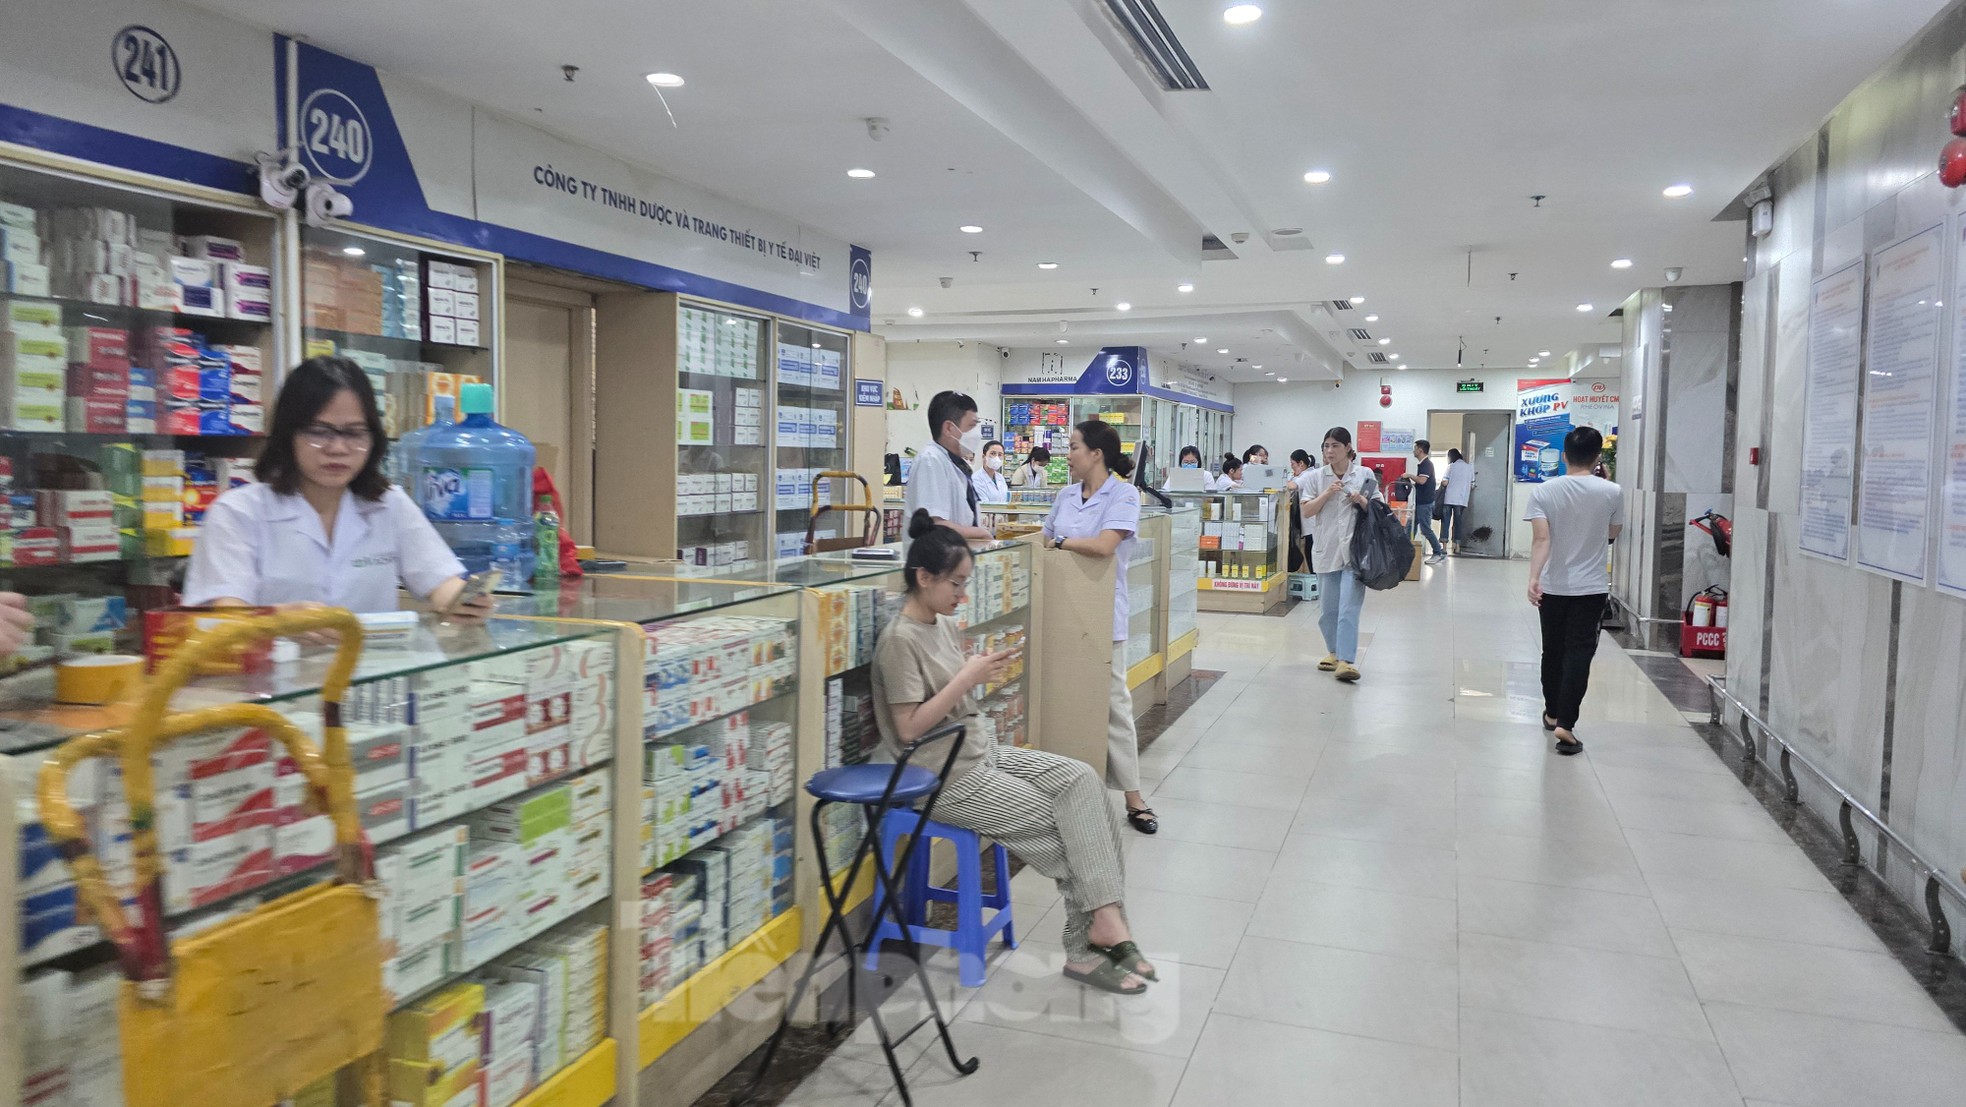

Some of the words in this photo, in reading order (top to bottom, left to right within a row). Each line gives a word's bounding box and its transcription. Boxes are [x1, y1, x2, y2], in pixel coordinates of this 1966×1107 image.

[122, 34, 169, 92] 241
[310, 108, 364, 164] 240
[533, 164, 578, 195] CÔNG
[580, 180, 598, 202] TY
[600, 187, 637, 215] TNHH
[639, 199, 673, 226] DƯỢC
[674, 209, 691, 231] VÀ
[692, 216, 728, 242] TRANG
[729, 228, 756, 250] THIẾT
[757, 237, 767, 257] BỊ
[768, 241, 774, 255] Y
[776, 241, 787, 260] TẾ
[788, 247, 803, 267] ĐẠI
[804, 251, 821, 272] VIỆT
[853, 271, 868, 295] 240
[1109, 366, 1129, 381] 233
[1553, 400, 1569, 411] PV
[1696, 632, 1720, 646] PCCC
